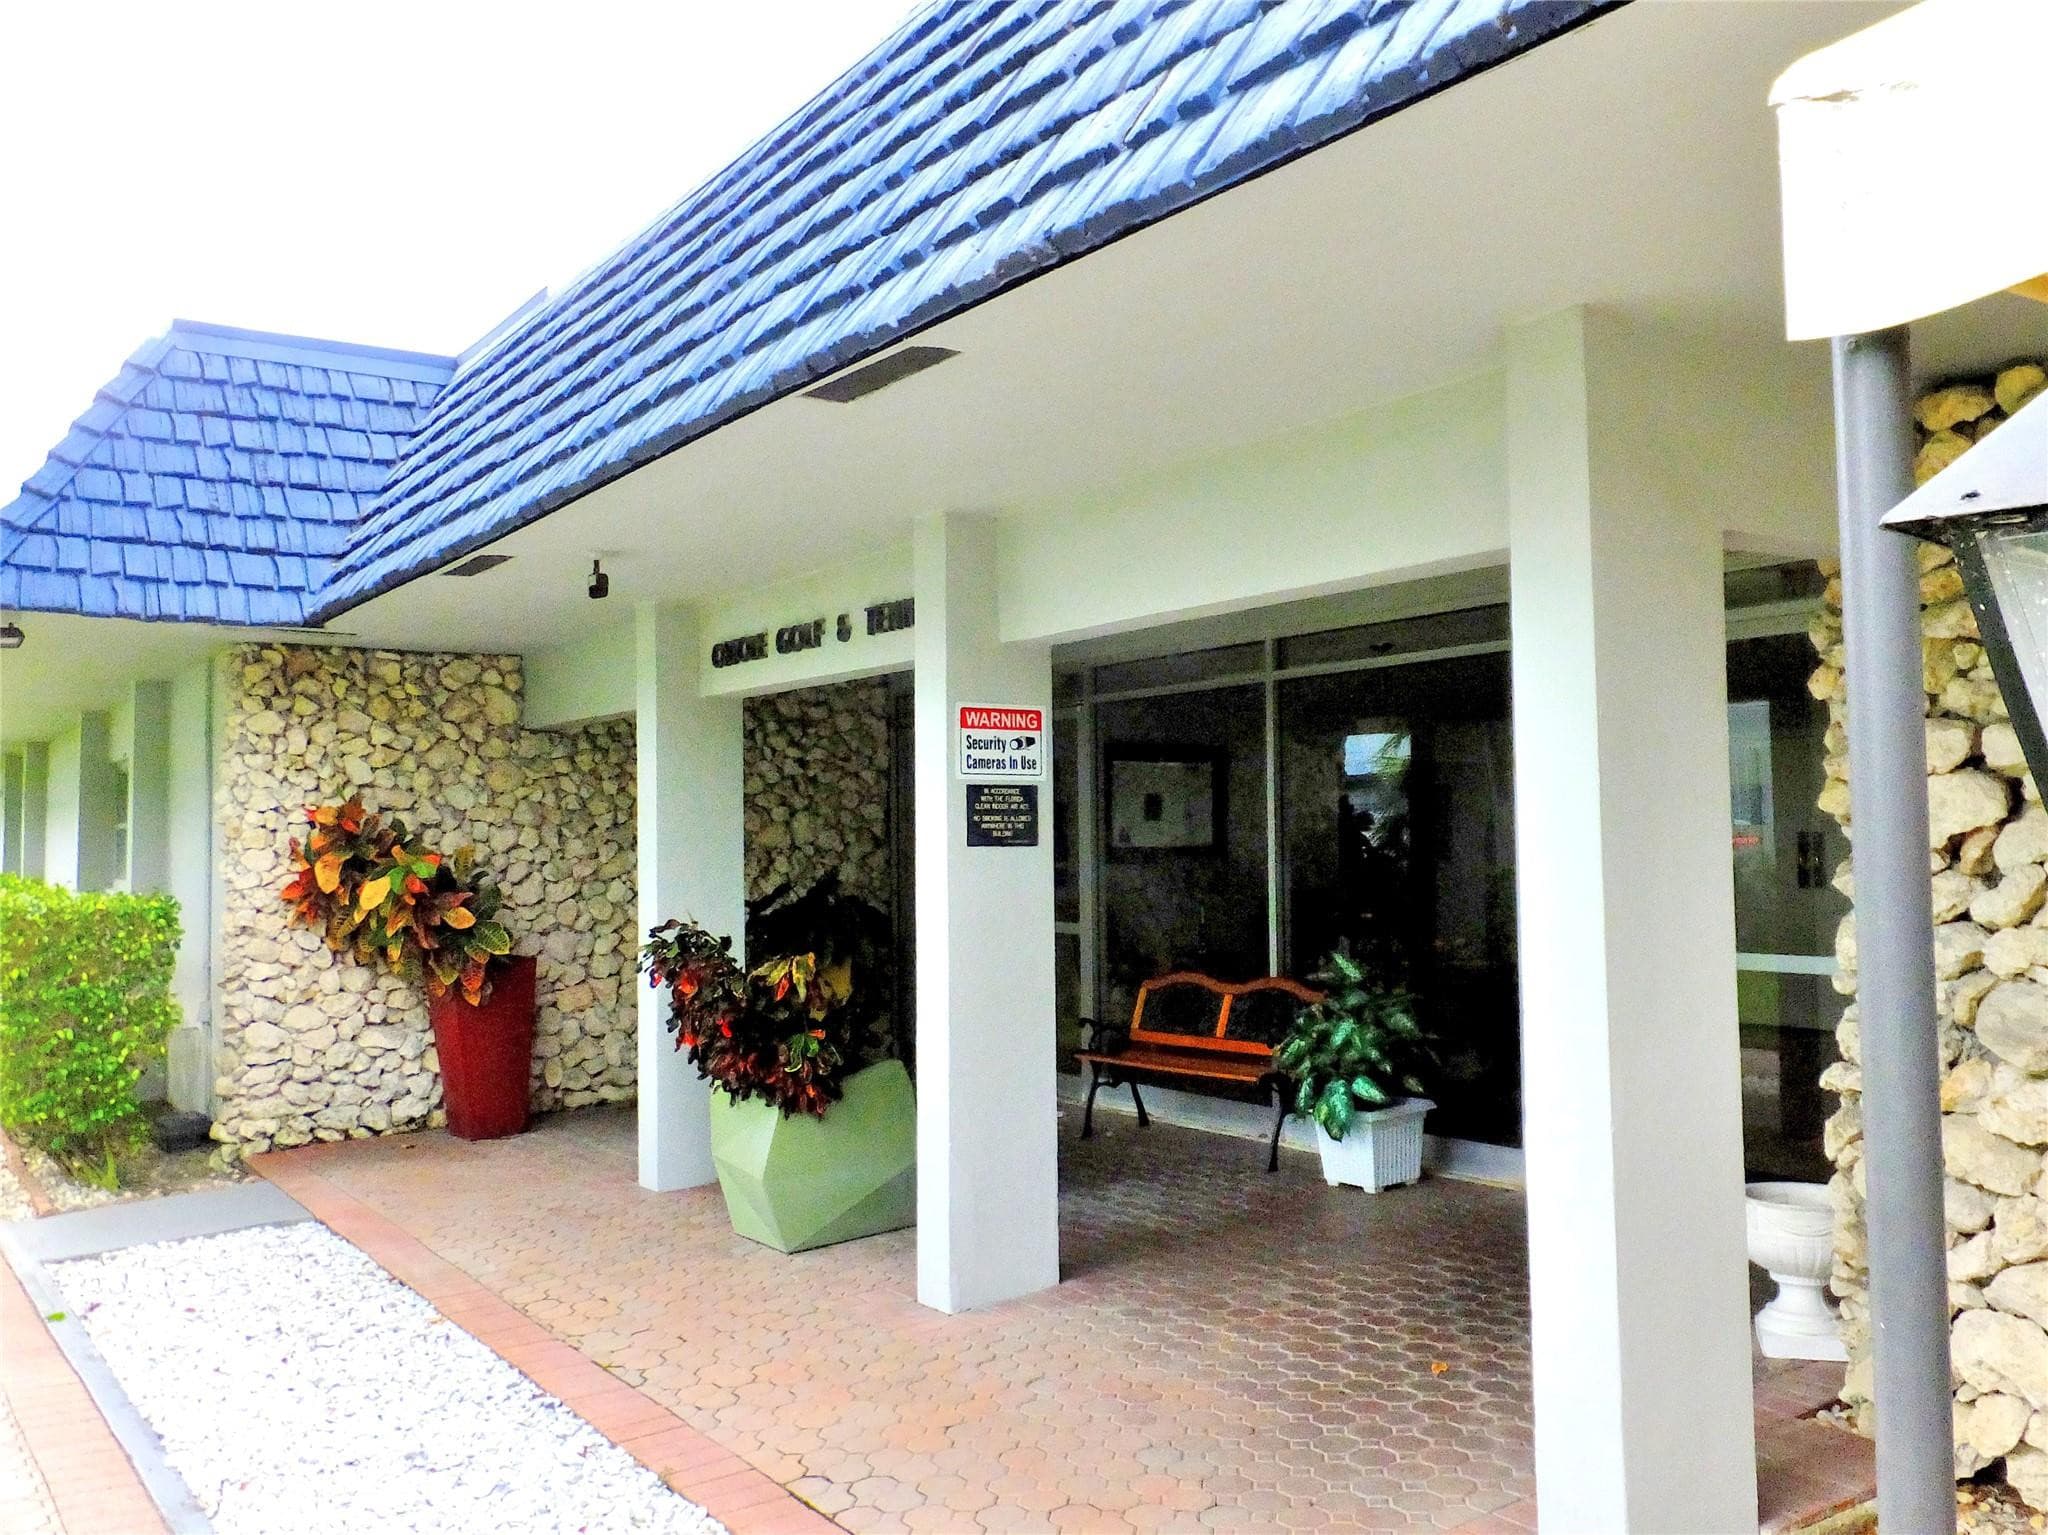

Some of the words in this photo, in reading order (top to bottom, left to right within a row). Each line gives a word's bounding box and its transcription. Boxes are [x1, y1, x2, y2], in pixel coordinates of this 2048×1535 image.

[837, 613, 852, 642] &
[966, 712, 1037, 728] WARNING
[966, 735, 1006, 753] Security
[966, 754, 1006, 769] Cameras
[1009, 755, 1018, 769] In
[1021, 755, 1036, 769] Use
